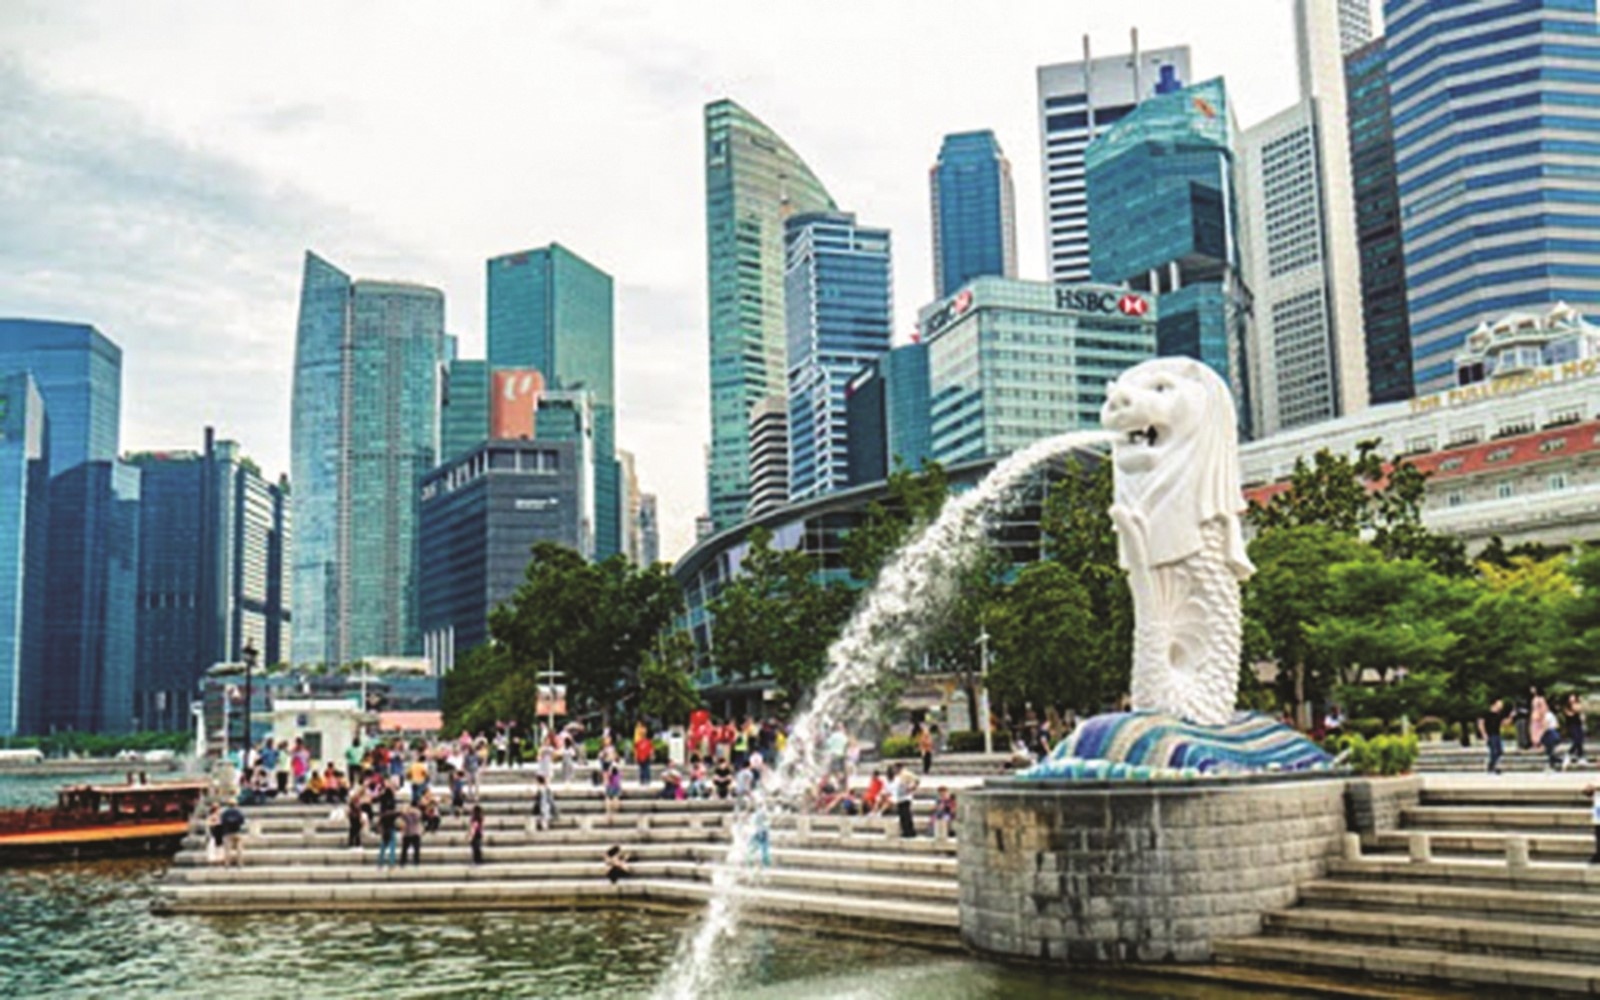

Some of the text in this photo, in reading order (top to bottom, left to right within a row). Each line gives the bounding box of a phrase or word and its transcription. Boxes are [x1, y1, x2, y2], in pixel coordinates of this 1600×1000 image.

[1055, 288, 1116, 314] HSBC
[1410, 394, 1441, 414] THE
[1561, 357, 1600, 378] HO
